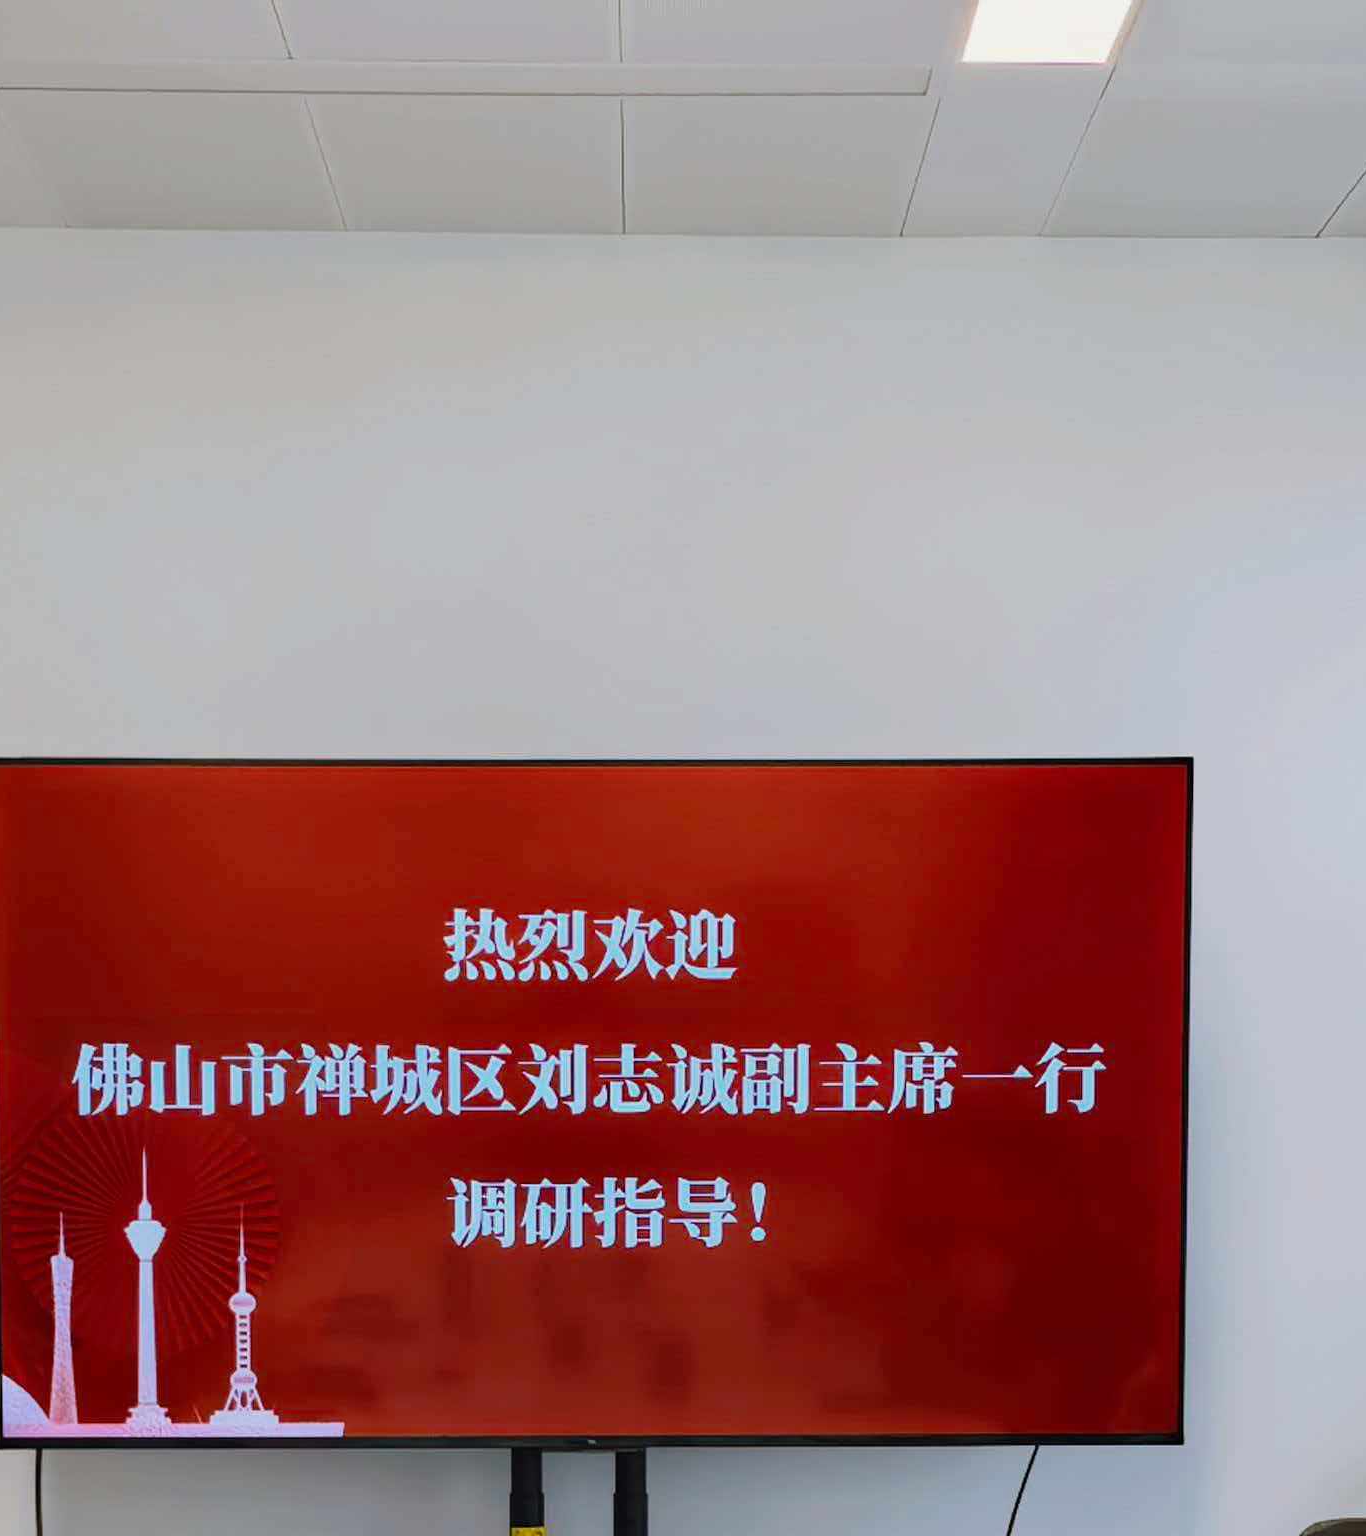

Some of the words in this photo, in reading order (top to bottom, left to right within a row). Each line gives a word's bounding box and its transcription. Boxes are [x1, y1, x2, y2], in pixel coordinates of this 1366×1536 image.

[443, 908, 736, 981] 热烈欢迎
[72, 1042, 1107, 1116] 佛山市禅城区刘志诚副主席一行
[447, 1177, 766, 1248] 调研指导!
